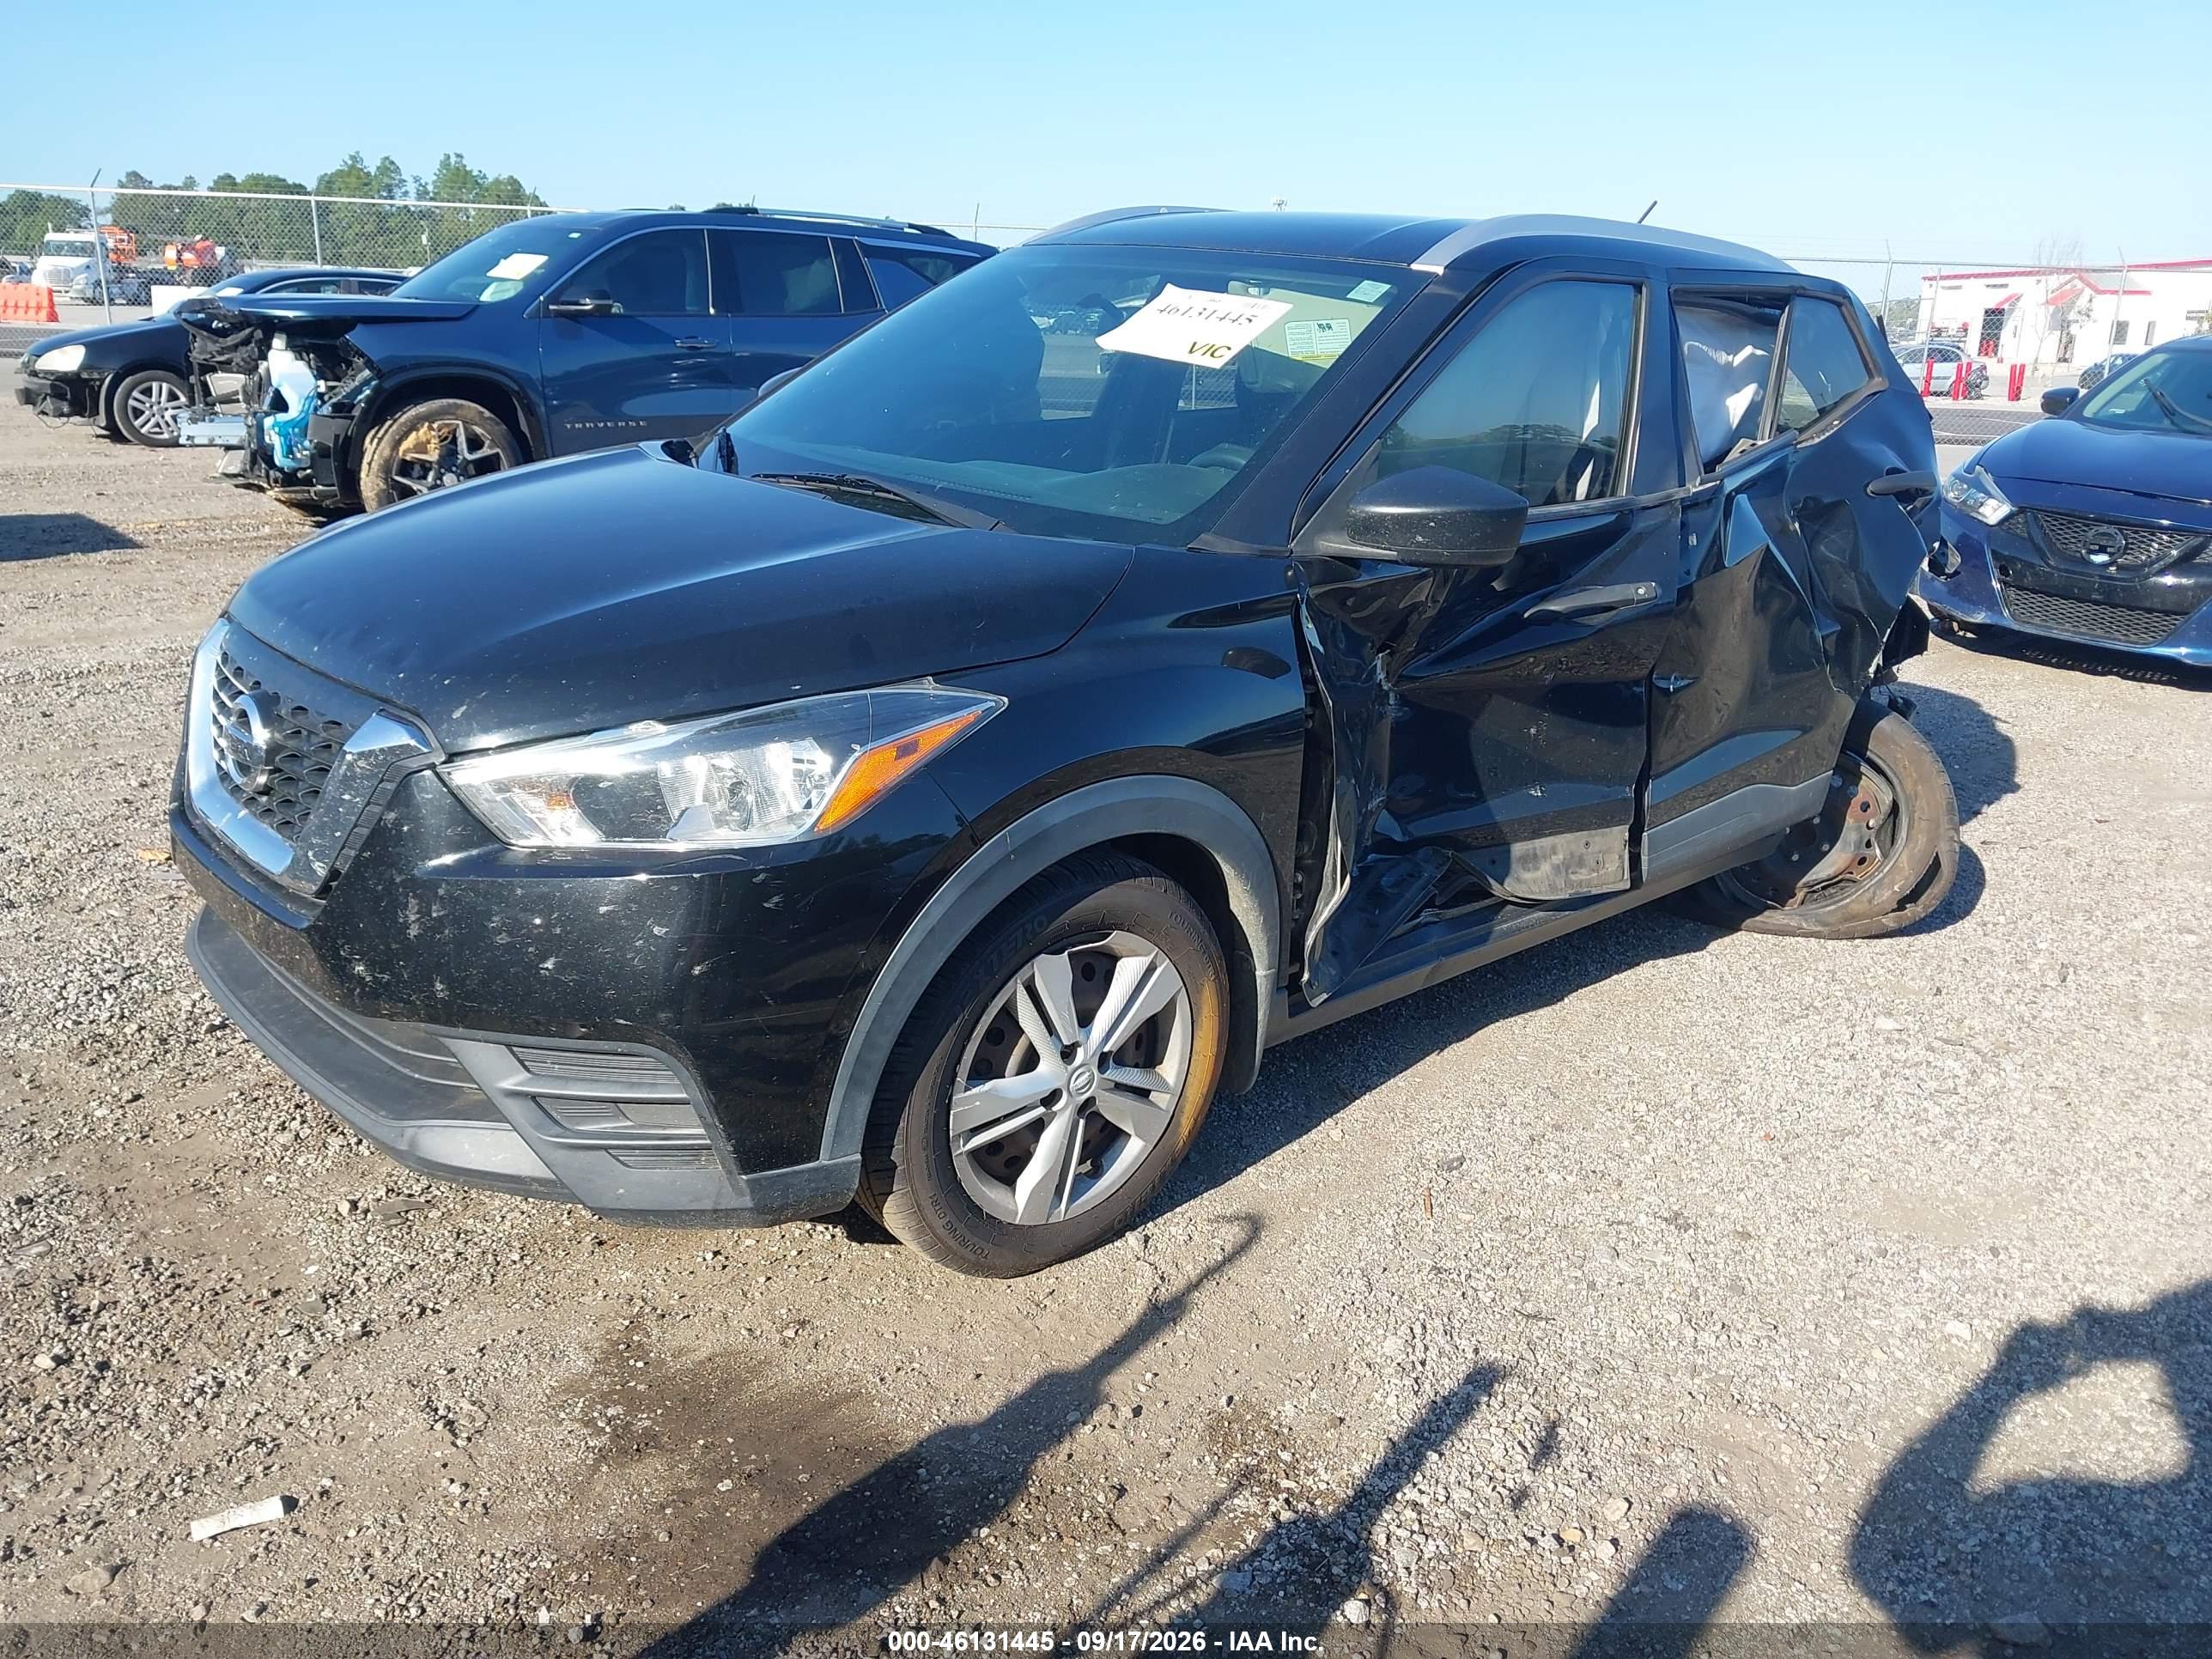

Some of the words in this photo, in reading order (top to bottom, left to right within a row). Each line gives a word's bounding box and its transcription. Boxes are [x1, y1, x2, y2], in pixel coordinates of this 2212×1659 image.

[1188, 341, 1231, 358] VIC
[563, 420, 647, 429] TRAVERSE
[942, 1219, 990, 1260] TOURING
